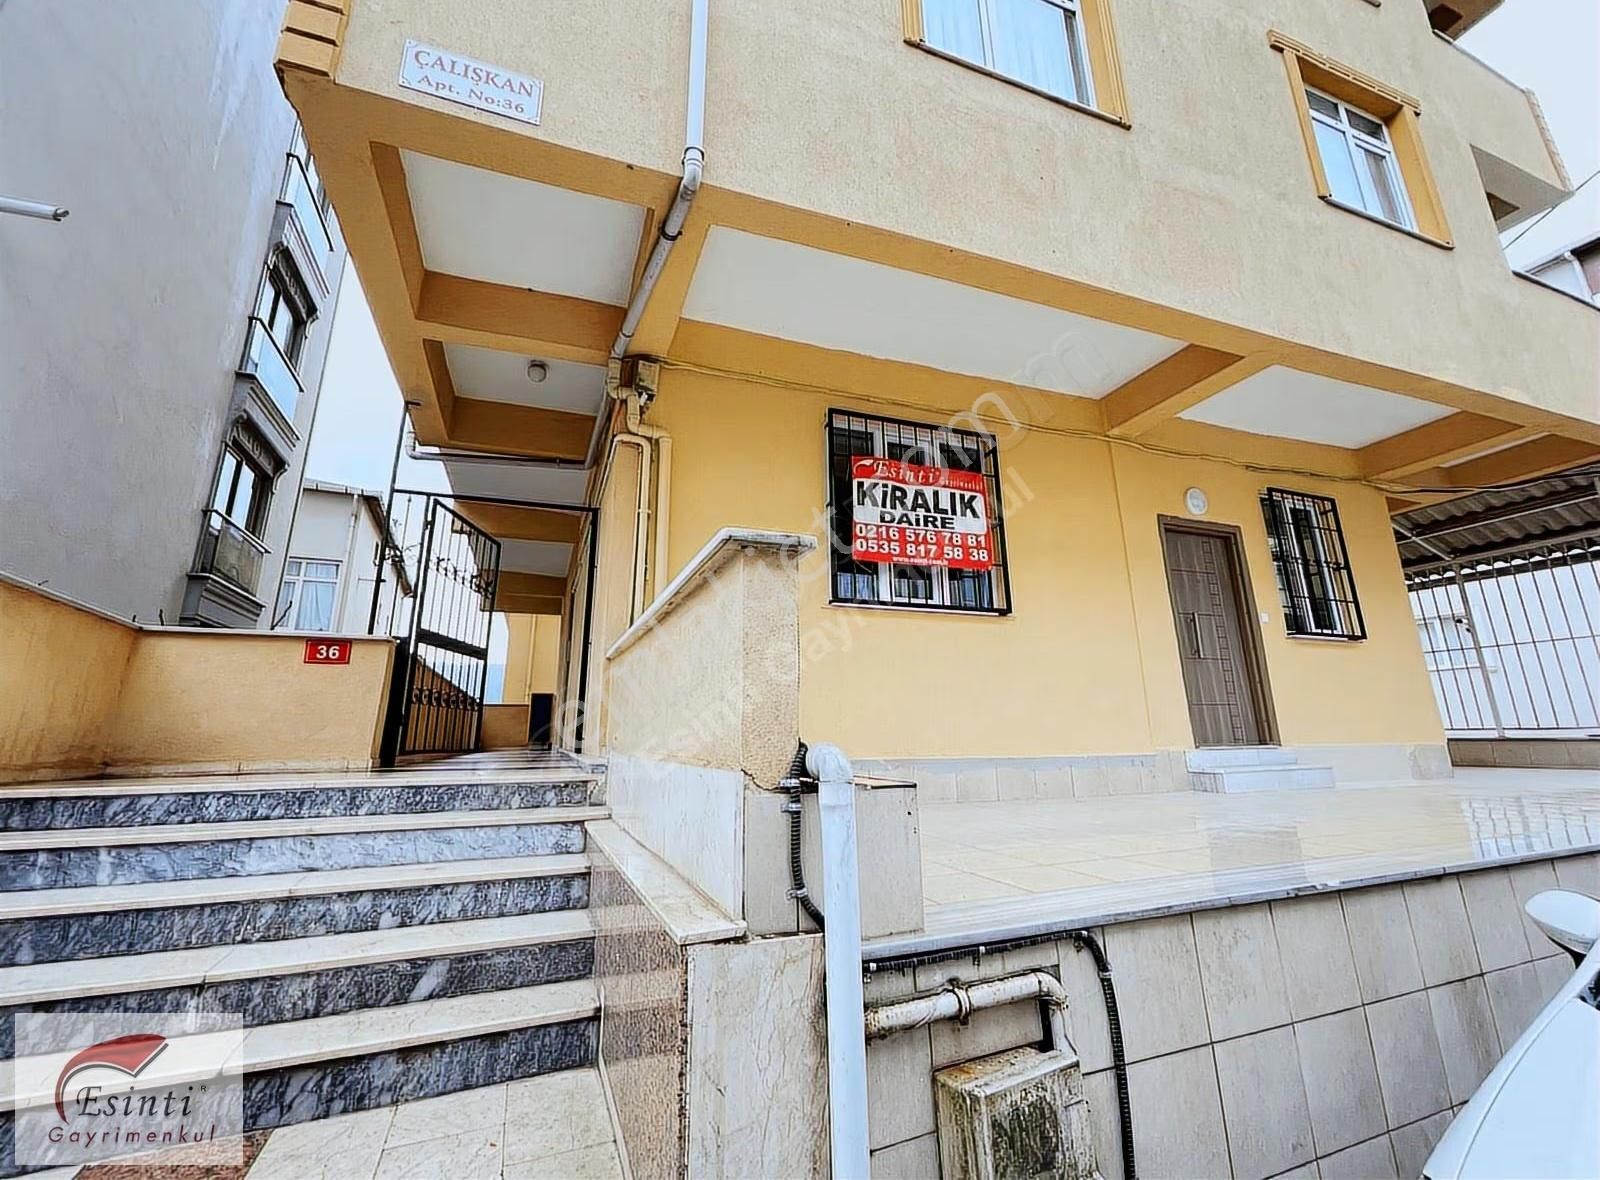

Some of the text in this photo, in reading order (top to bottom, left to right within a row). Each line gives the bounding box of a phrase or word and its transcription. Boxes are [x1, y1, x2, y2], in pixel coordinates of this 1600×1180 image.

[414, 50, 534, 98] ÇALIŞKAN
[417, 74, 525, 114] Apt. No:36
[873, 459, 937, 484] Esinti
[855, 523, 986, 548] 0216 576 78 81
[855, 538, 989, 562] 0535 817 58 38
[316, 645, 340, 659] 36
